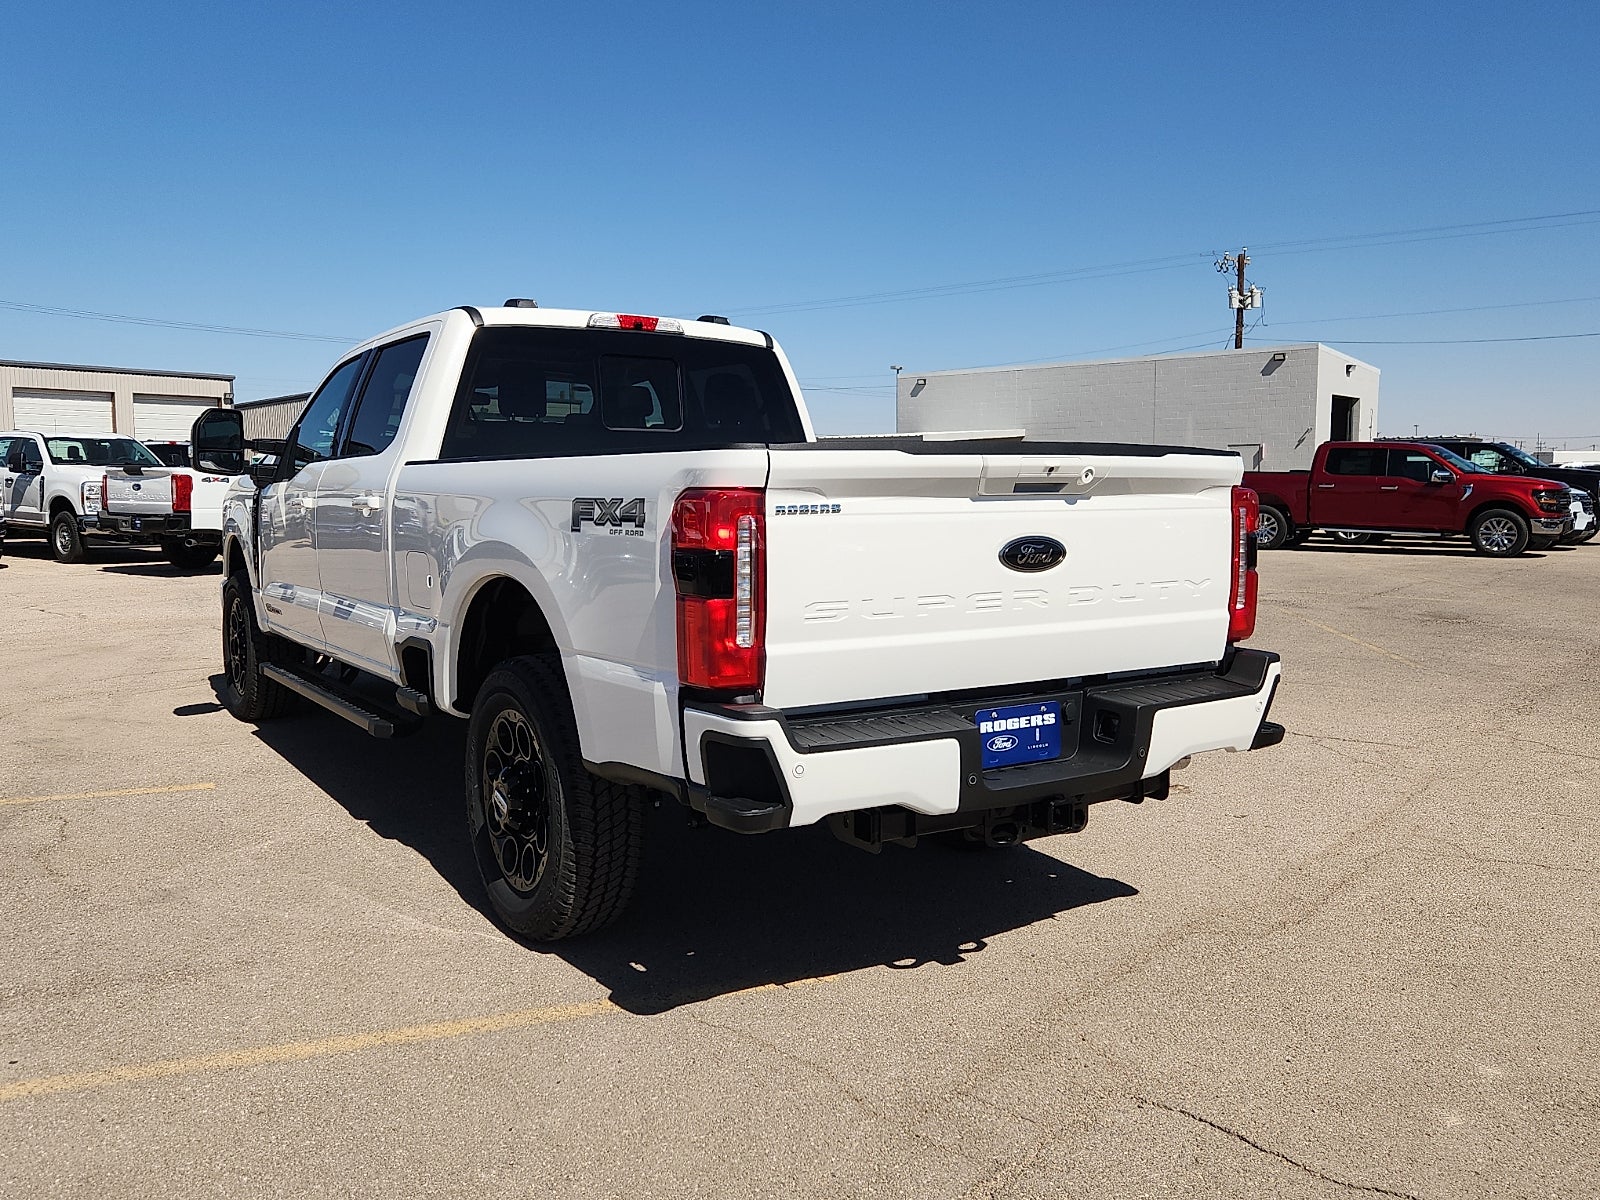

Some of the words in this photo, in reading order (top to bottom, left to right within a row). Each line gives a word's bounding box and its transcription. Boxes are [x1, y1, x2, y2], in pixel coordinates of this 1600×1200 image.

[571, 497, 646, 533] FX4
[775, 504, 841, 516] ROGERS
[609, 528, 624, 536] OFF
[624, 529, 644, 537] ROAD
[1017, 543, 1053, 565] Ford
[803, 588, 1049, 624] SUPER
[1067, 577, 1211, 607] DUTY
[980, 713, 1055, 733] ROGERS
[992, 737, 1013, 750] Ford
